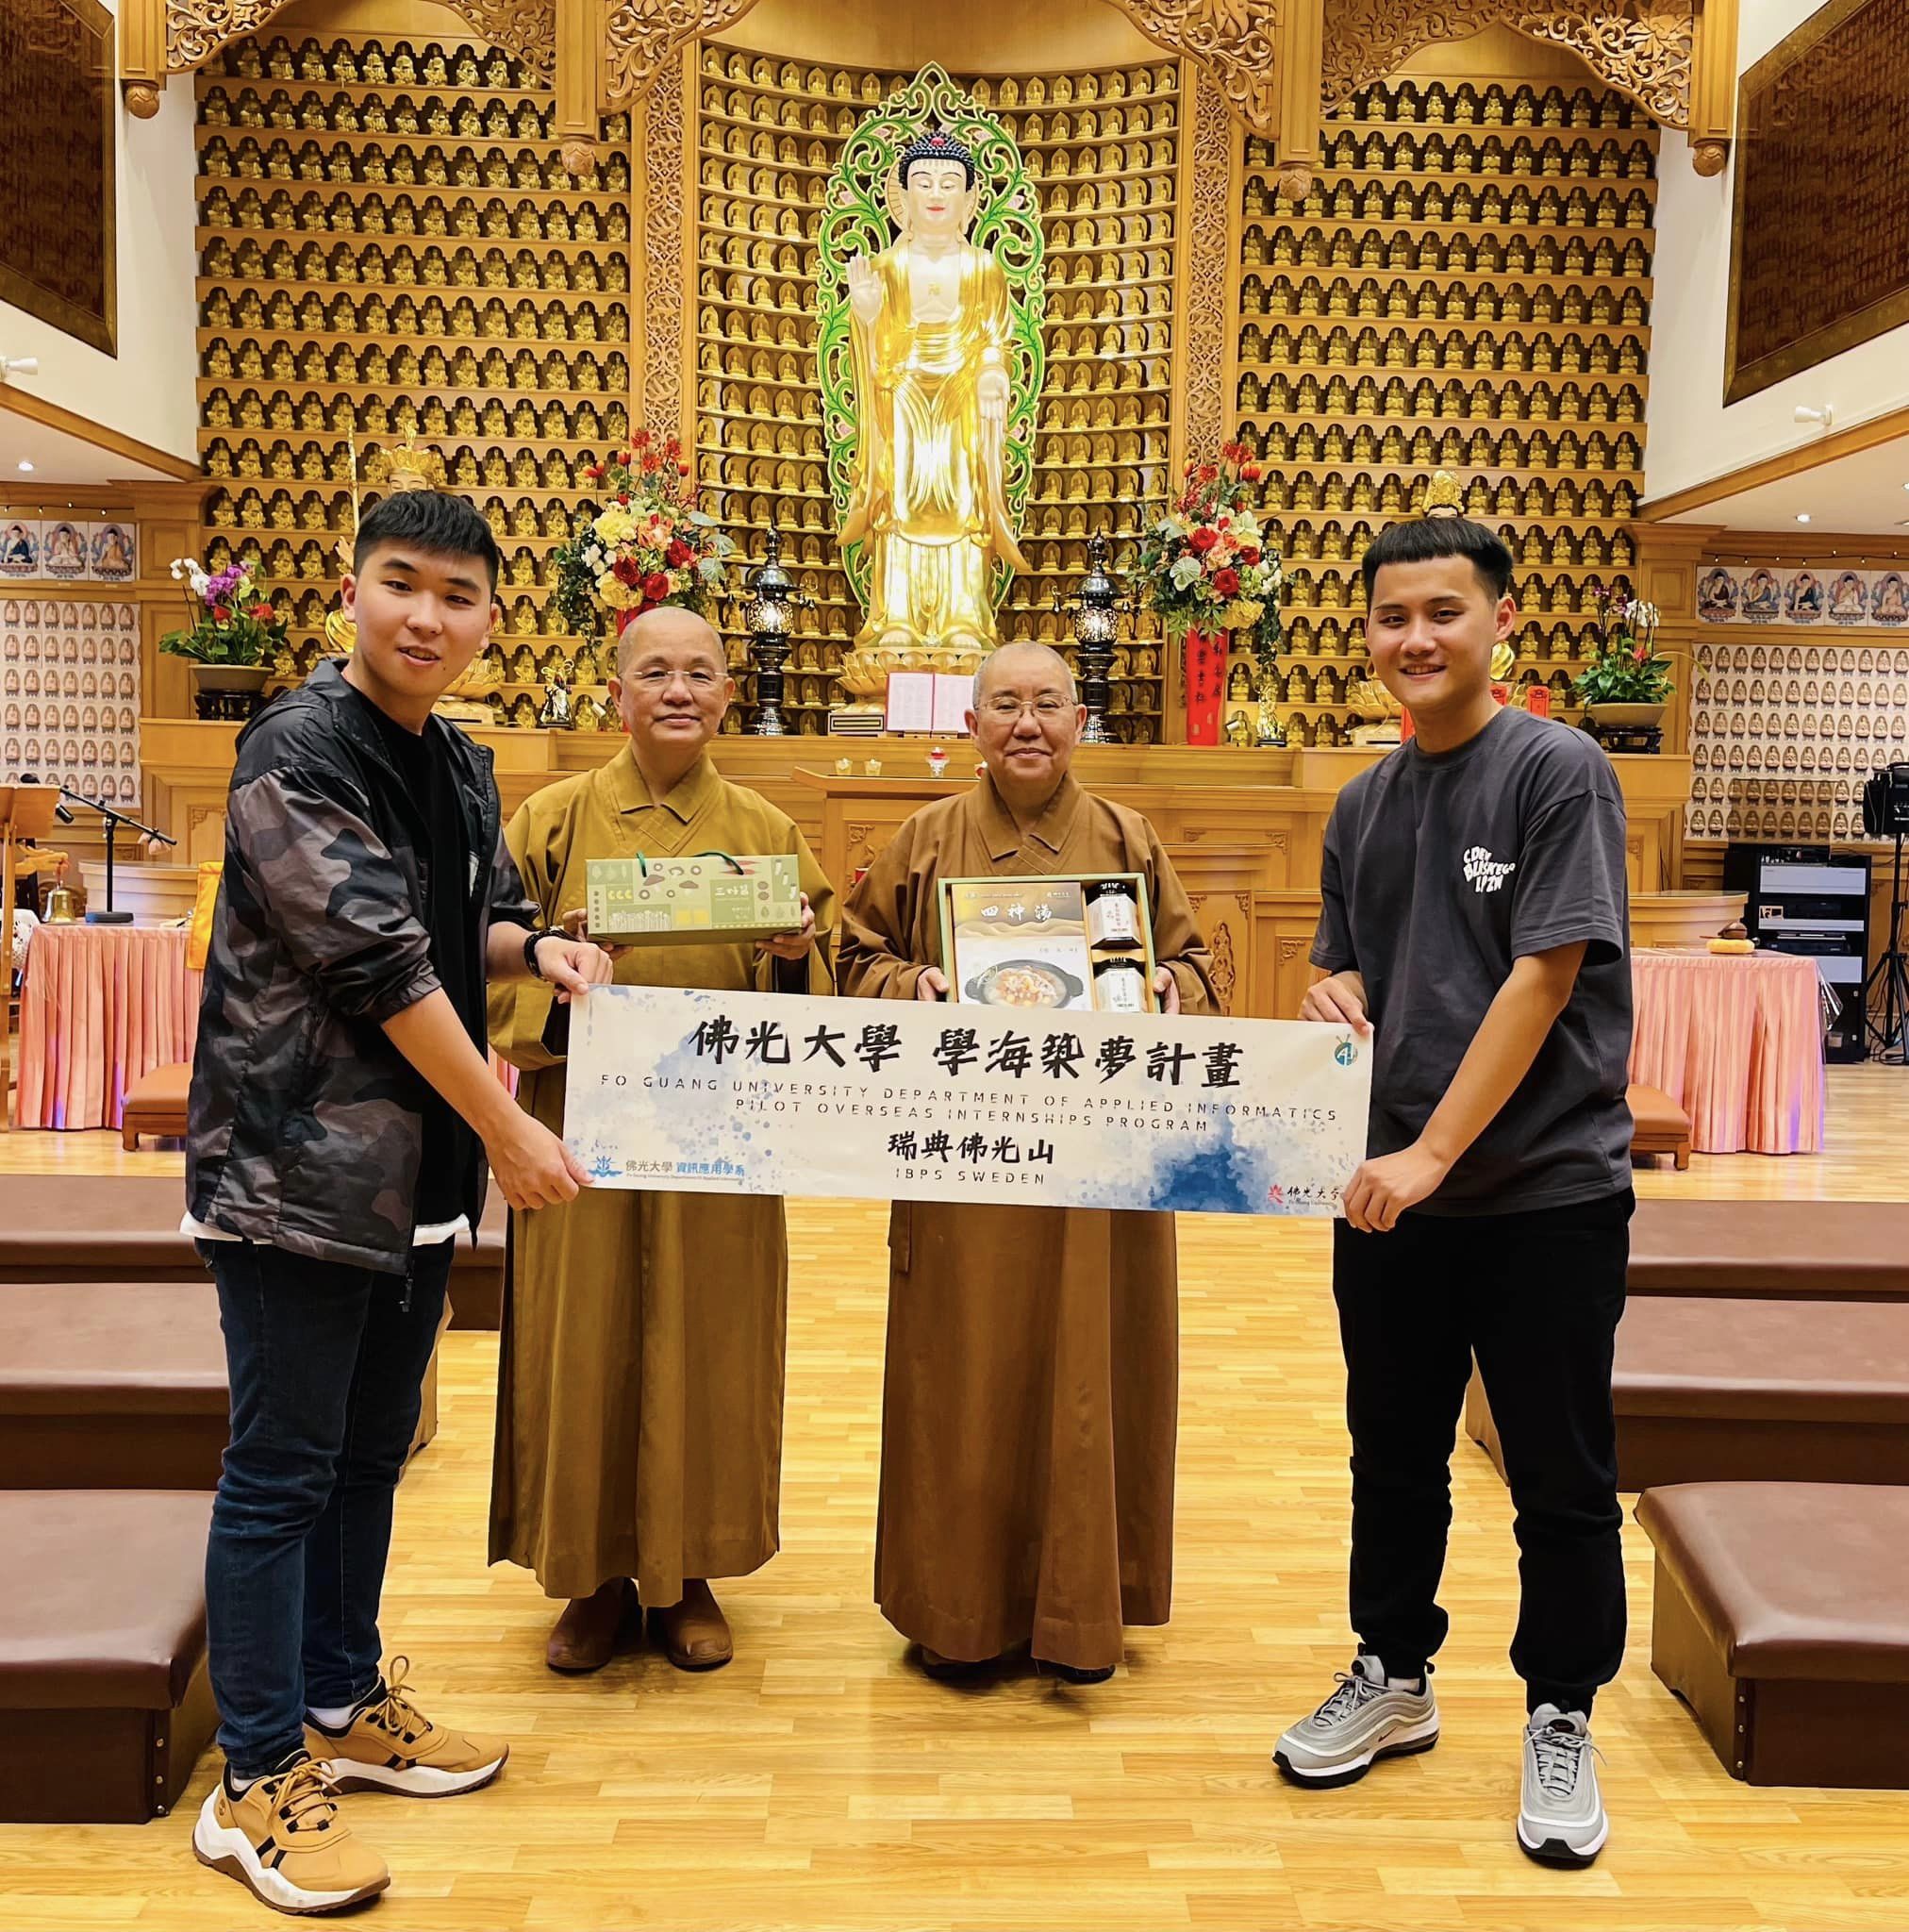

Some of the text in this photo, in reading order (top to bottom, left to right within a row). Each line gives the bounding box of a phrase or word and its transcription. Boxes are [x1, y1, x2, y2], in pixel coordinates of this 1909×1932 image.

[981, 902, 1053, 922] 四神湯
[689, 1014, 1244, 1090] 佛光大學 學海築夢計畫
[601, 1074, 1337, 1121] FO GUANG UNIVERSITY DEPARTMENT OF APPLIED INFORMATICS
[736, 1098, 1208, 1132] PILOT OVERSEAS INTERNSHIPS PROGRAM
[888, 1129, 1054, 1165] 瑞典佛光山
[626, 1160, 745, 1177] 佛光大學 資訊應用學系
[895, 1167, 1045, 1185] IBPS SWEDEN
